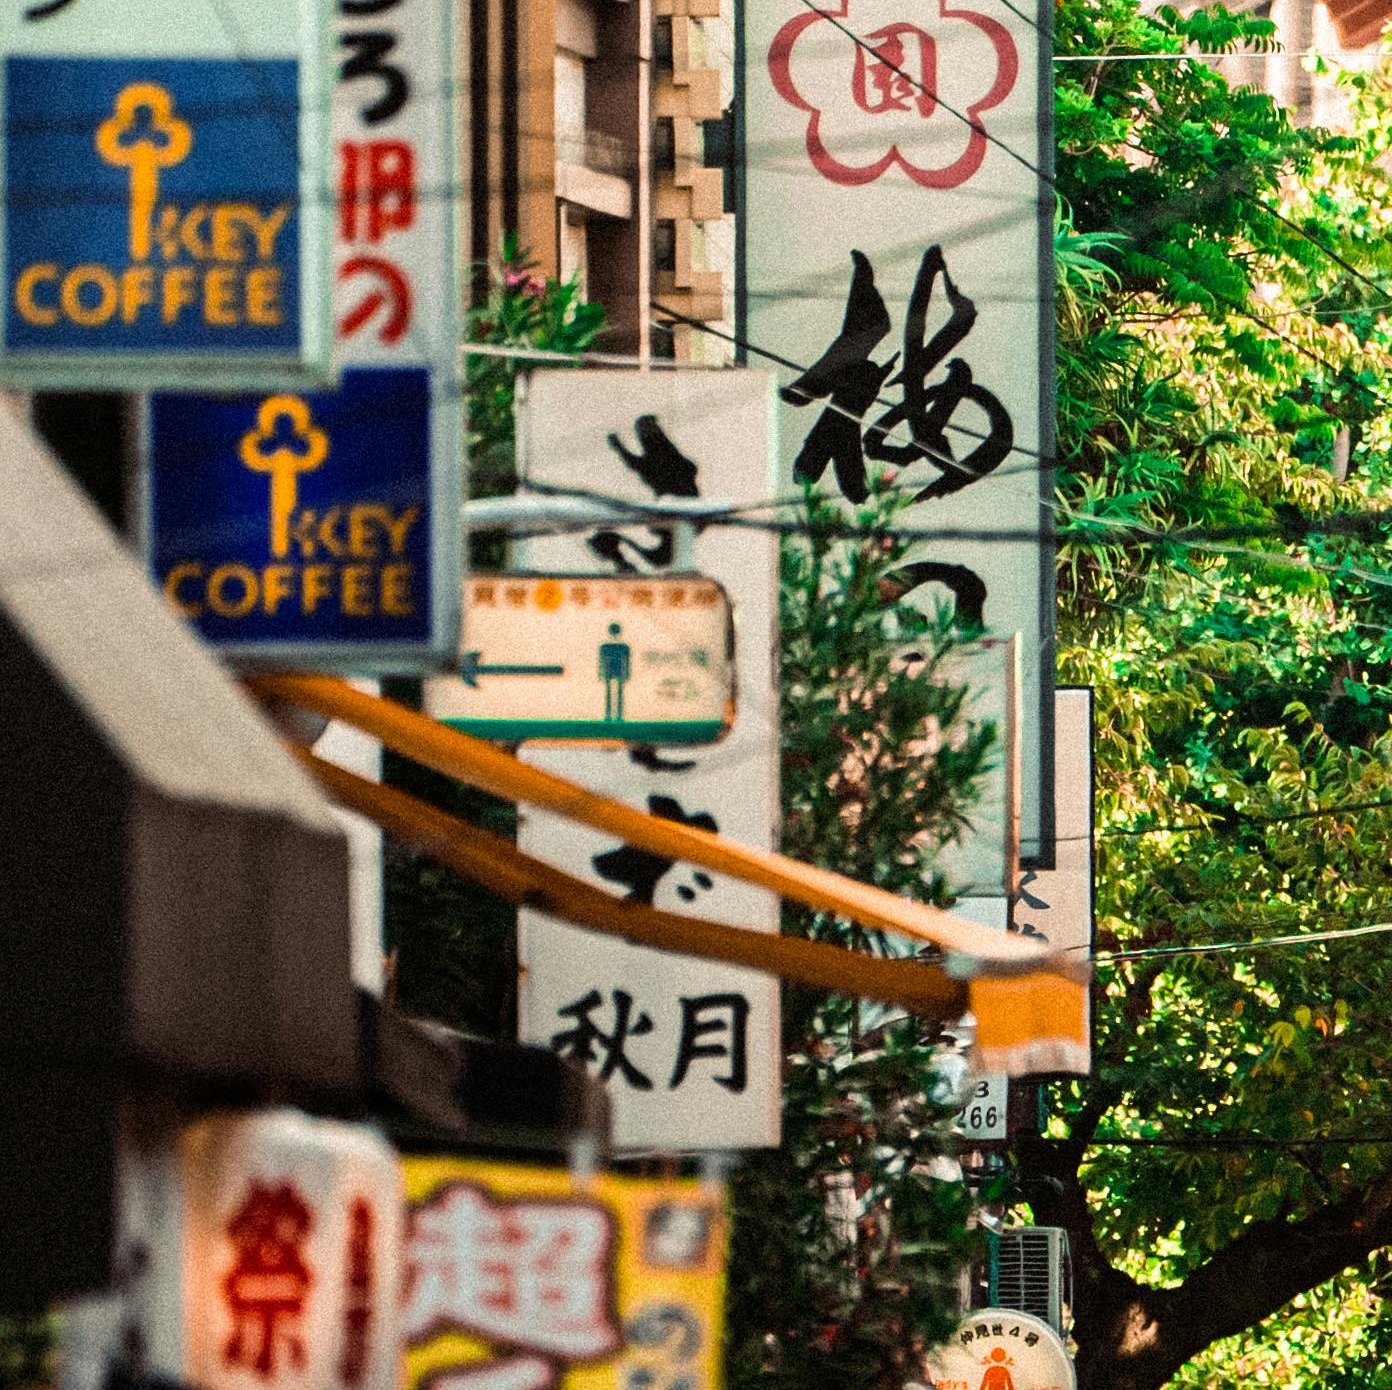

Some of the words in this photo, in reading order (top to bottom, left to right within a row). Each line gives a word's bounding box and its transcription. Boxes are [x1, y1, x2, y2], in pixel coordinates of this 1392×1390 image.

[156, 203, 289, 261] KEY
[14, 265, 284, 326] COFFEE
[291, 504, 420, 558] KEY
[163, 563, 416, 617] COFFEE
[548, 988, 750, 1094] 秋月
